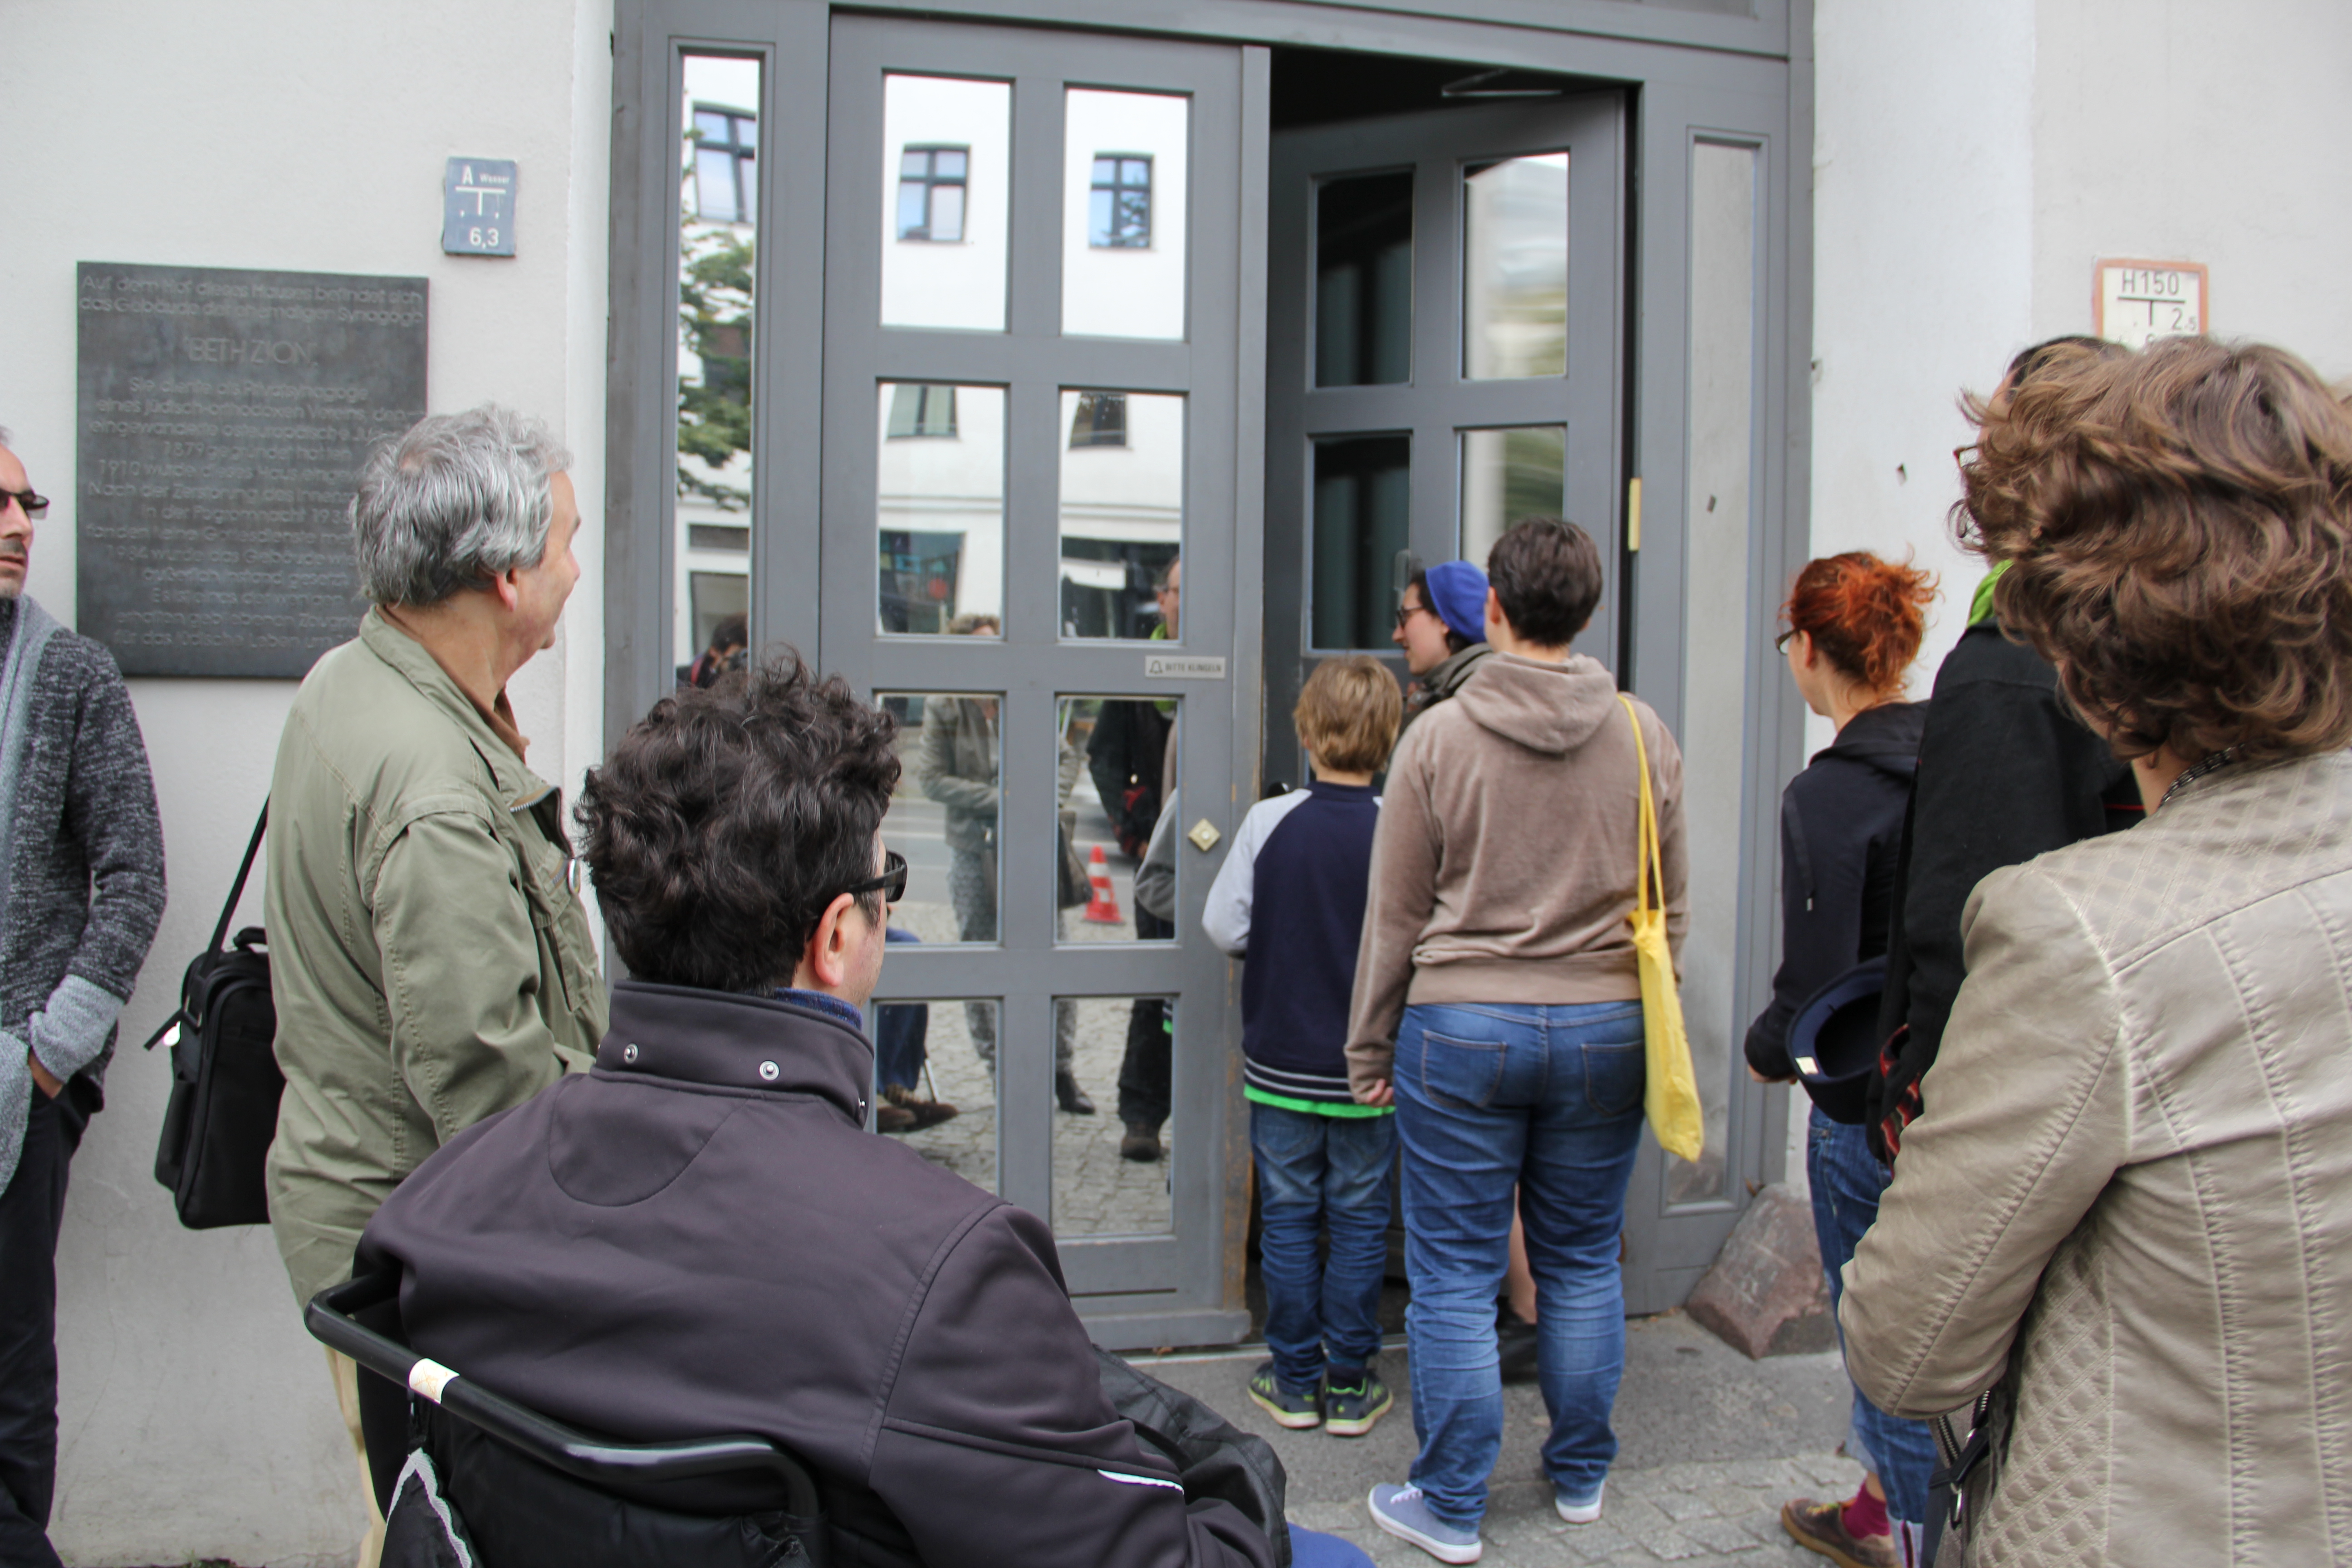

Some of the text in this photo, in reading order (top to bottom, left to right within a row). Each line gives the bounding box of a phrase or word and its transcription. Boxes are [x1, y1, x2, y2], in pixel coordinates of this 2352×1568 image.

[462, 165, 473, 185] A
[470, 227, 499, 250] 6,3
[1166, 663, 1221, 672] BITTE KLINGELN
